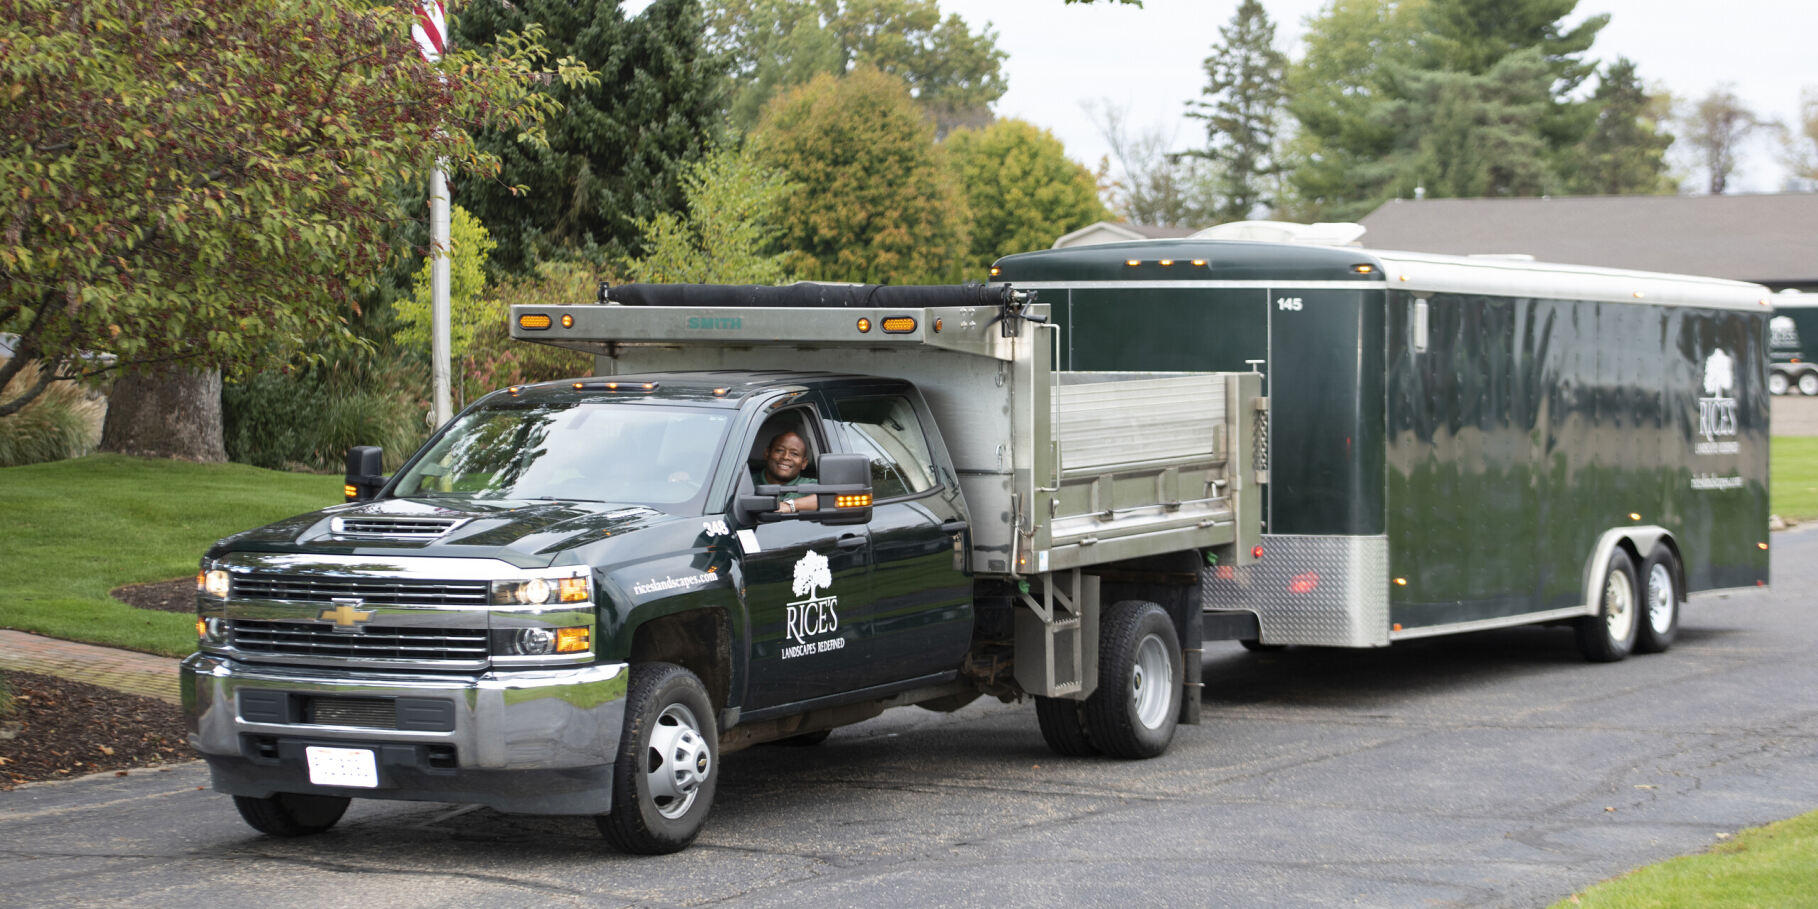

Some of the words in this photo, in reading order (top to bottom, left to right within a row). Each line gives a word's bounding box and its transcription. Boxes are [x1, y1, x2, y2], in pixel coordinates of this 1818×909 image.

[1277, 297, 1303, 311] 145
[688, 317, 742, 329] SMITH
[703, 520, 729, 537] 348
[633, 572, 718, 595] riceslandscapes.com
[786, 599, 838, 644] RICE'S
[781, 643, 816, 659] LANDSCAPES
[817, 637, 845, 653] REDEFINED
